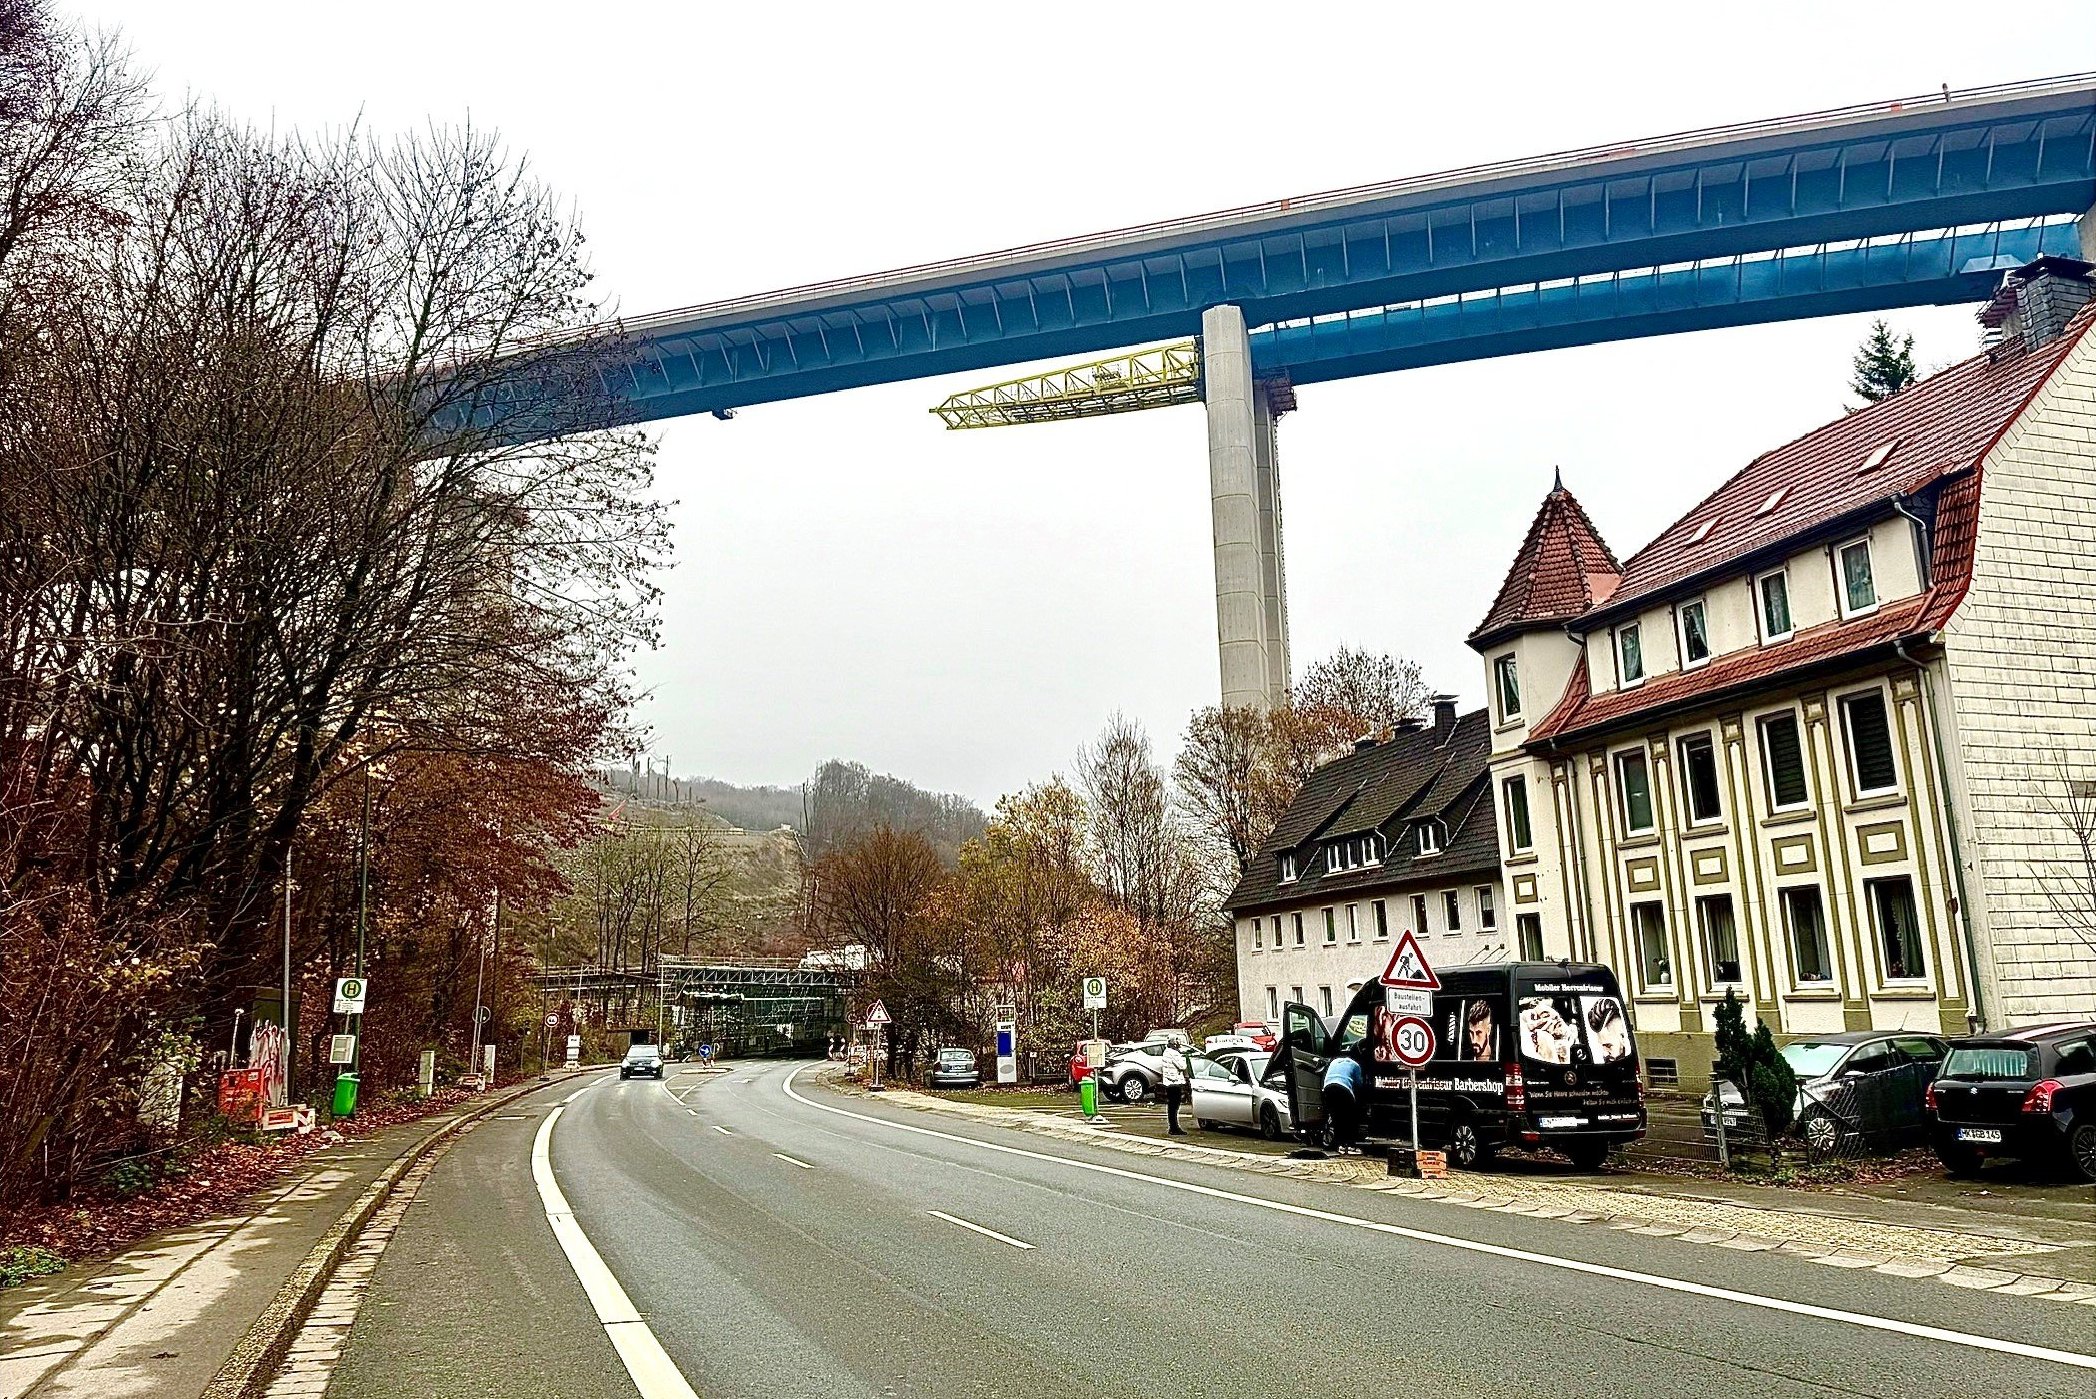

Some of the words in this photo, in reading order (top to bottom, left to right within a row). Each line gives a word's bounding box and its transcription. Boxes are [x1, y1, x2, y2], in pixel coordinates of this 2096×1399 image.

[346, 983, 357, 995] H
[1091, 982, 1099, 993] H
[1534, 983, 1560, 992] Mobiler
[1394, 992, 1425, 1002] Baustellen-
[1398, 1003, 1422, 1012] ausfahrt
[1400, 1029, 1426, 1053] 30
[1454, 1077, 1504, 1096] Barbershop
[1986, 1131, 2000, 1139] 145
